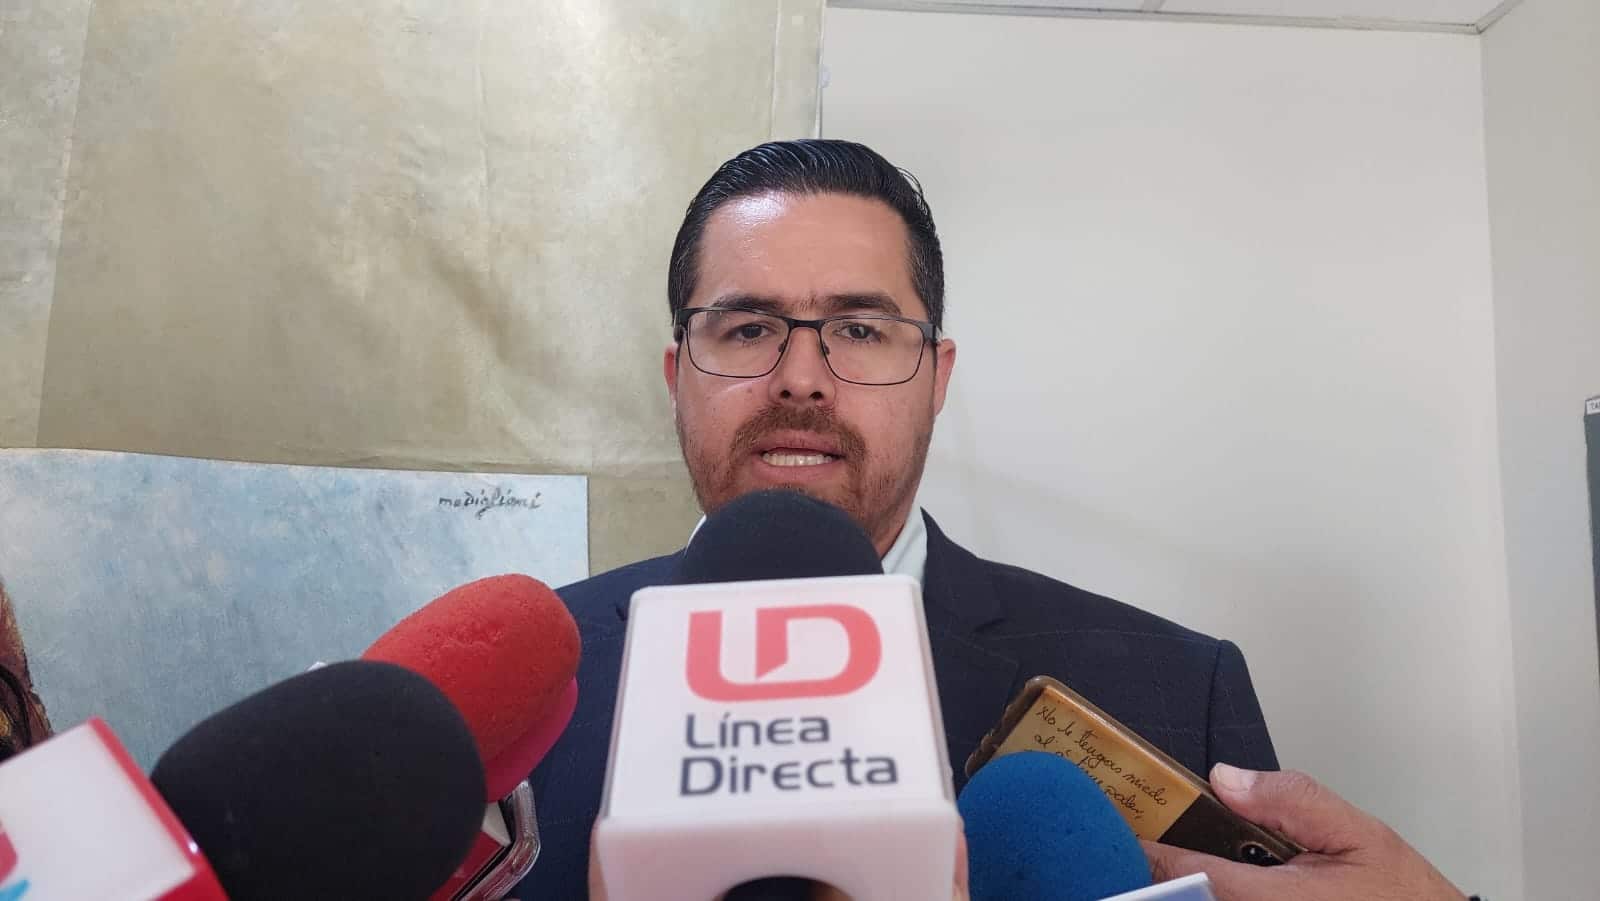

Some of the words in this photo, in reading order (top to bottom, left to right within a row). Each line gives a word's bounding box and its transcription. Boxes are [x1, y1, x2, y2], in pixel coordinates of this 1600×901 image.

[686, 713, 830, 749] Línea
[680, 748, 898, 796] Directa
[1074, 730, 1122, 774] tengas
[1123, 773, 1168, 806] miedo
